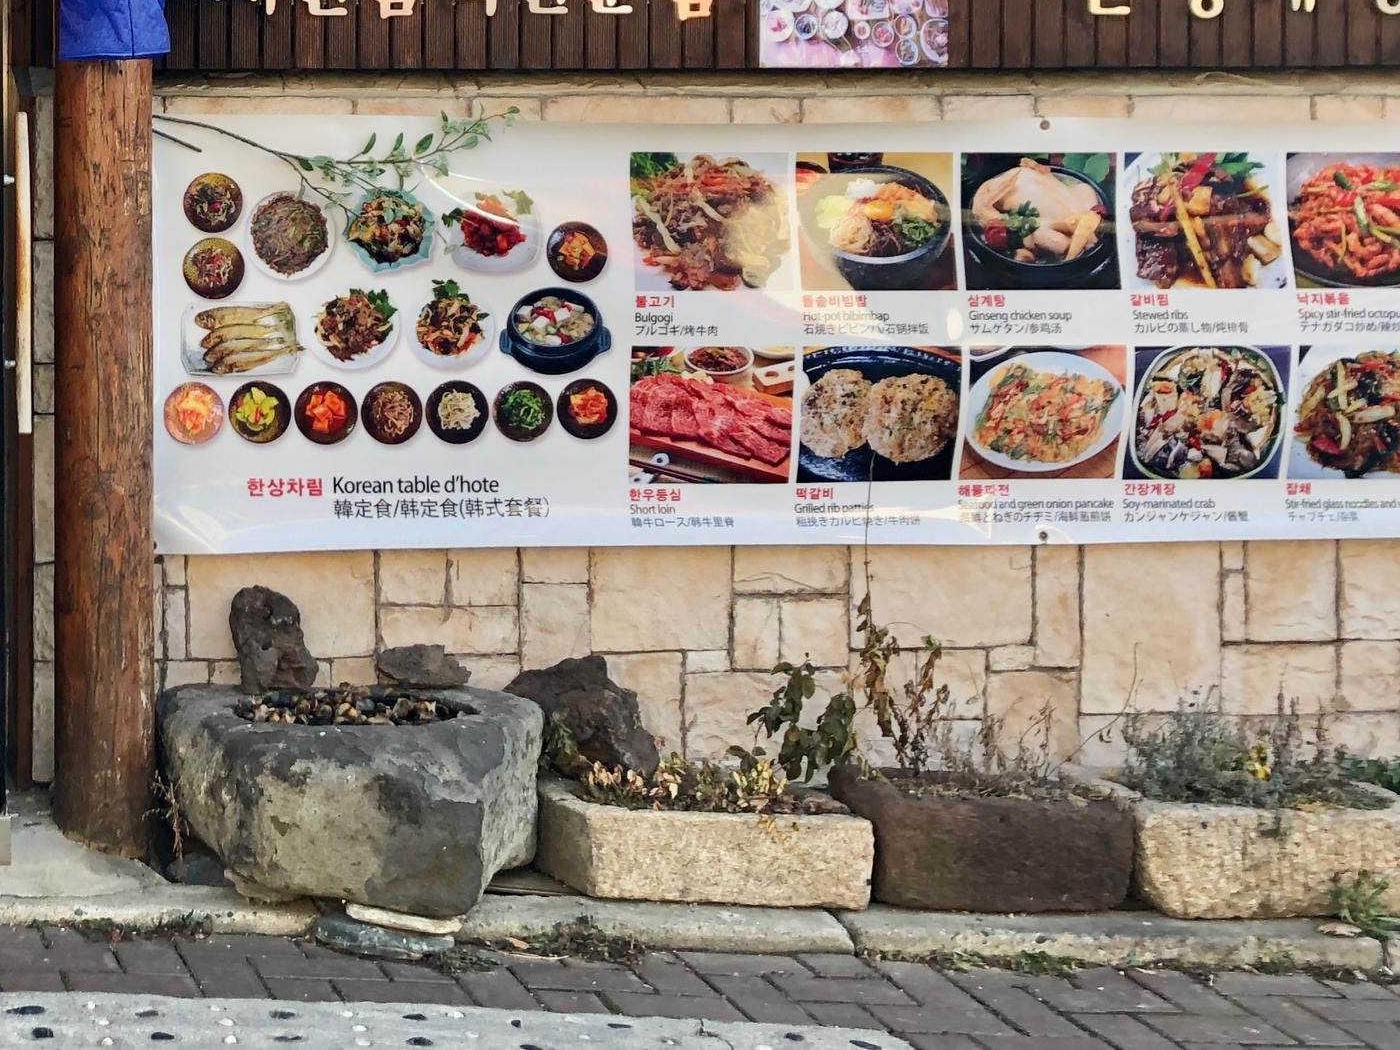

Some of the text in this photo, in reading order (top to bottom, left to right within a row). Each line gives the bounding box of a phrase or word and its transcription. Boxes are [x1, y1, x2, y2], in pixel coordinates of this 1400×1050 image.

[635, 295, 675, 308] 불고기
[968, 294, 1005, 307] 삼계탕
[1130, 294, 1169, 307] 갈비찜
[1296, 292, 1351, 305] 낙지볶음
[634, 312, 674, 325] Bulgogi
[968, 309, 1072, 322] Ginseng chicken soup
[1132, 309, 1188, 320] Stewed ribs
[1298, 308, 1324, 321] Spicy
[1326, 308, 1366, 319] stir-fried
[246, 477, 323, 497] 한상차림
[332, 476, 393, 494] Korean
[396, 475, 440, 494] table
[958, 484, 1010, 497] 해물파전
[1124, 483, 1175, 496] 간장게장
[1286, 483, 1312, 495] 잡채
[629, 488, 681, 502] 한우등심
[796, 487, 834, 500] 떡갈비
[629, 504, 676, 515] Short loin
[794, 502, 826, 514] Grilled
[827, 502, 841, 513] rib
[999, 499, 1016, 509] and
[1018, 500, 1045, 511] green
[1046, 499, 1074, 509] onion
[1075, 498, 1114, 510] pancake
[1123, 498, 1216, 510] Soy-marinated crab
